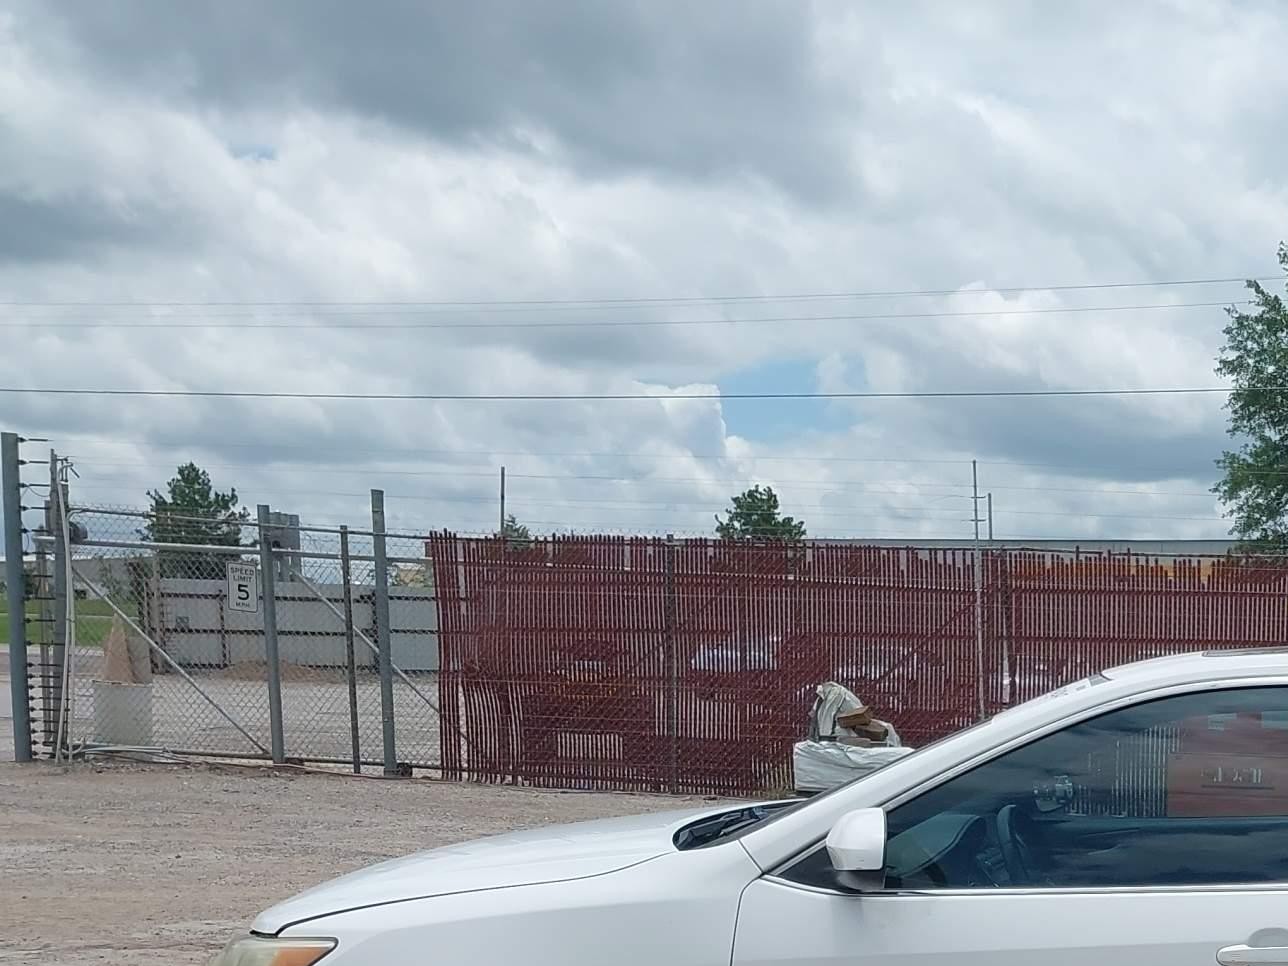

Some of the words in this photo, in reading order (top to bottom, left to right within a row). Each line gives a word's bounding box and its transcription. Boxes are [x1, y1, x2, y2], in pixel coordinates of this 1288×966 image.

[230, 566, 255, 576] SPEED
[233, 574, 253, 583] LIMIT
[237, 583, 250, 601] 5
